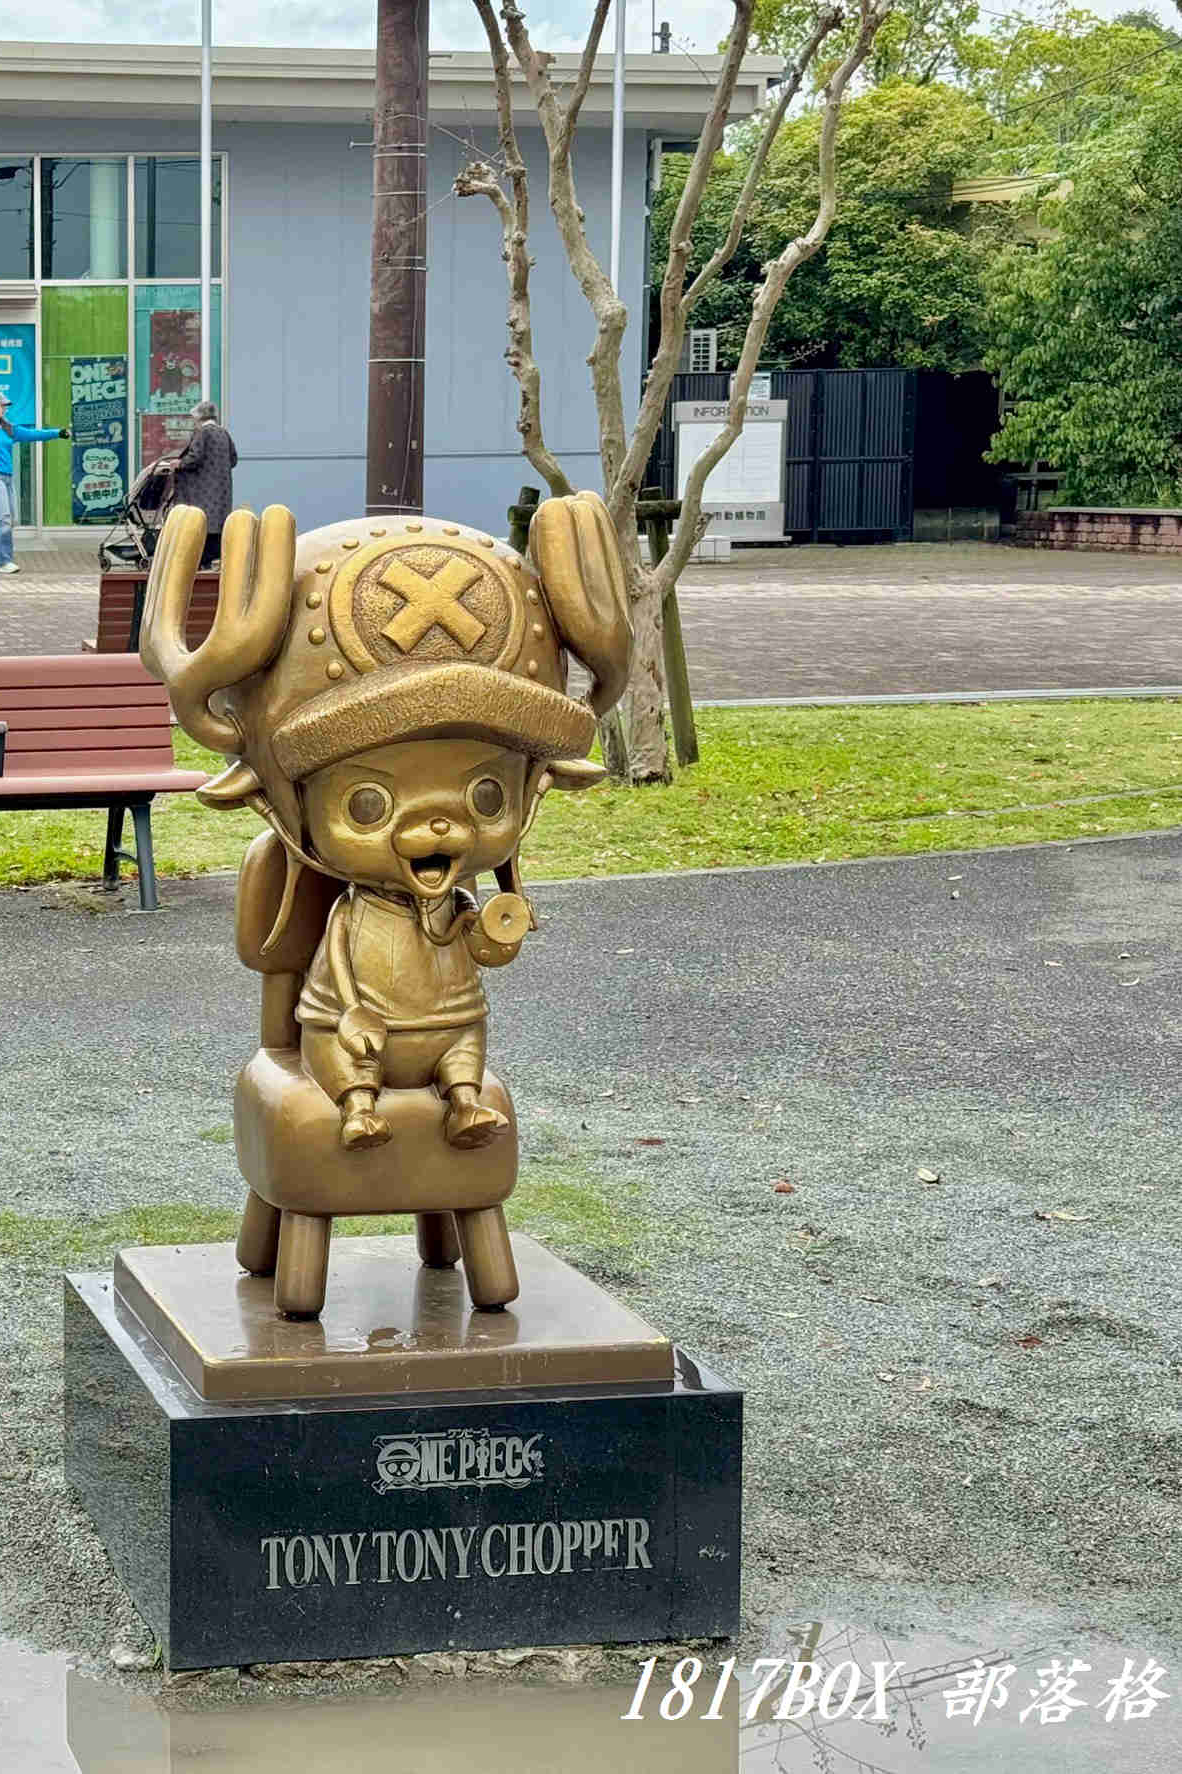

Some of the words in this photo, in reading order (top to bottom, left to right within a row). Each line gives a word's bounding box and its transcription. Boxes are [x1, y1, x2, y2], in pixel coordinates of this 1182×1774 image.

[71, 363, 111, 385] ONE
[72, 380, 127, 404] PIECE
[447, 1428, 491, 1439] ワンピース
[261, 1532, 366, 1590] TONY
[371, 1526, 478, 1583] TONY
[480, 1517, 653, 1578] CHOPPER
